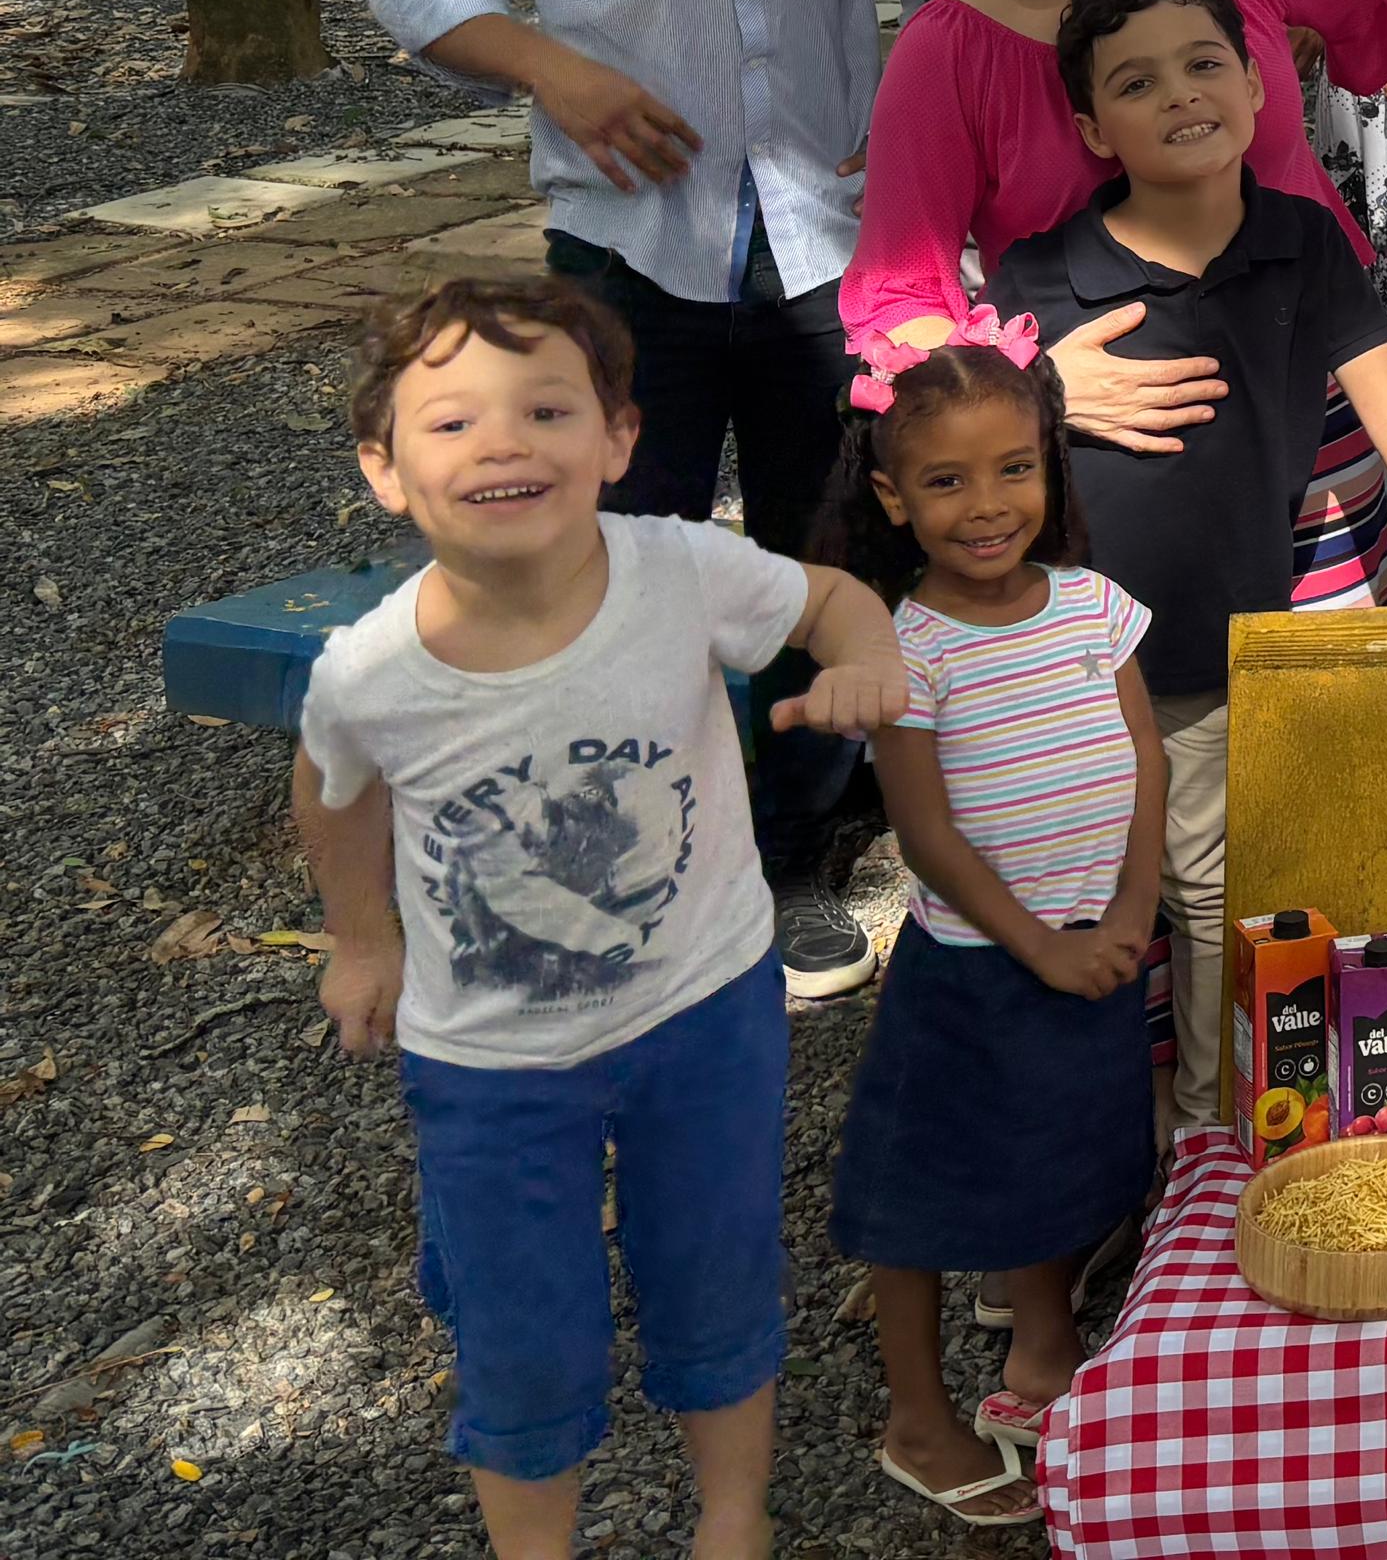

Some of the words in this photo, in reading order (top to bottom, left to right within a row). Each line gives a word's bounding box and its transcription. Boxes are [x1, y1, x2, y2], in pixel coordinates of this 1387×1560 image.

[568, 738, 673, 769] DAY
[1282, 1004, 1297, 1016] del
[1369, 1028, 1385, 1039] del
